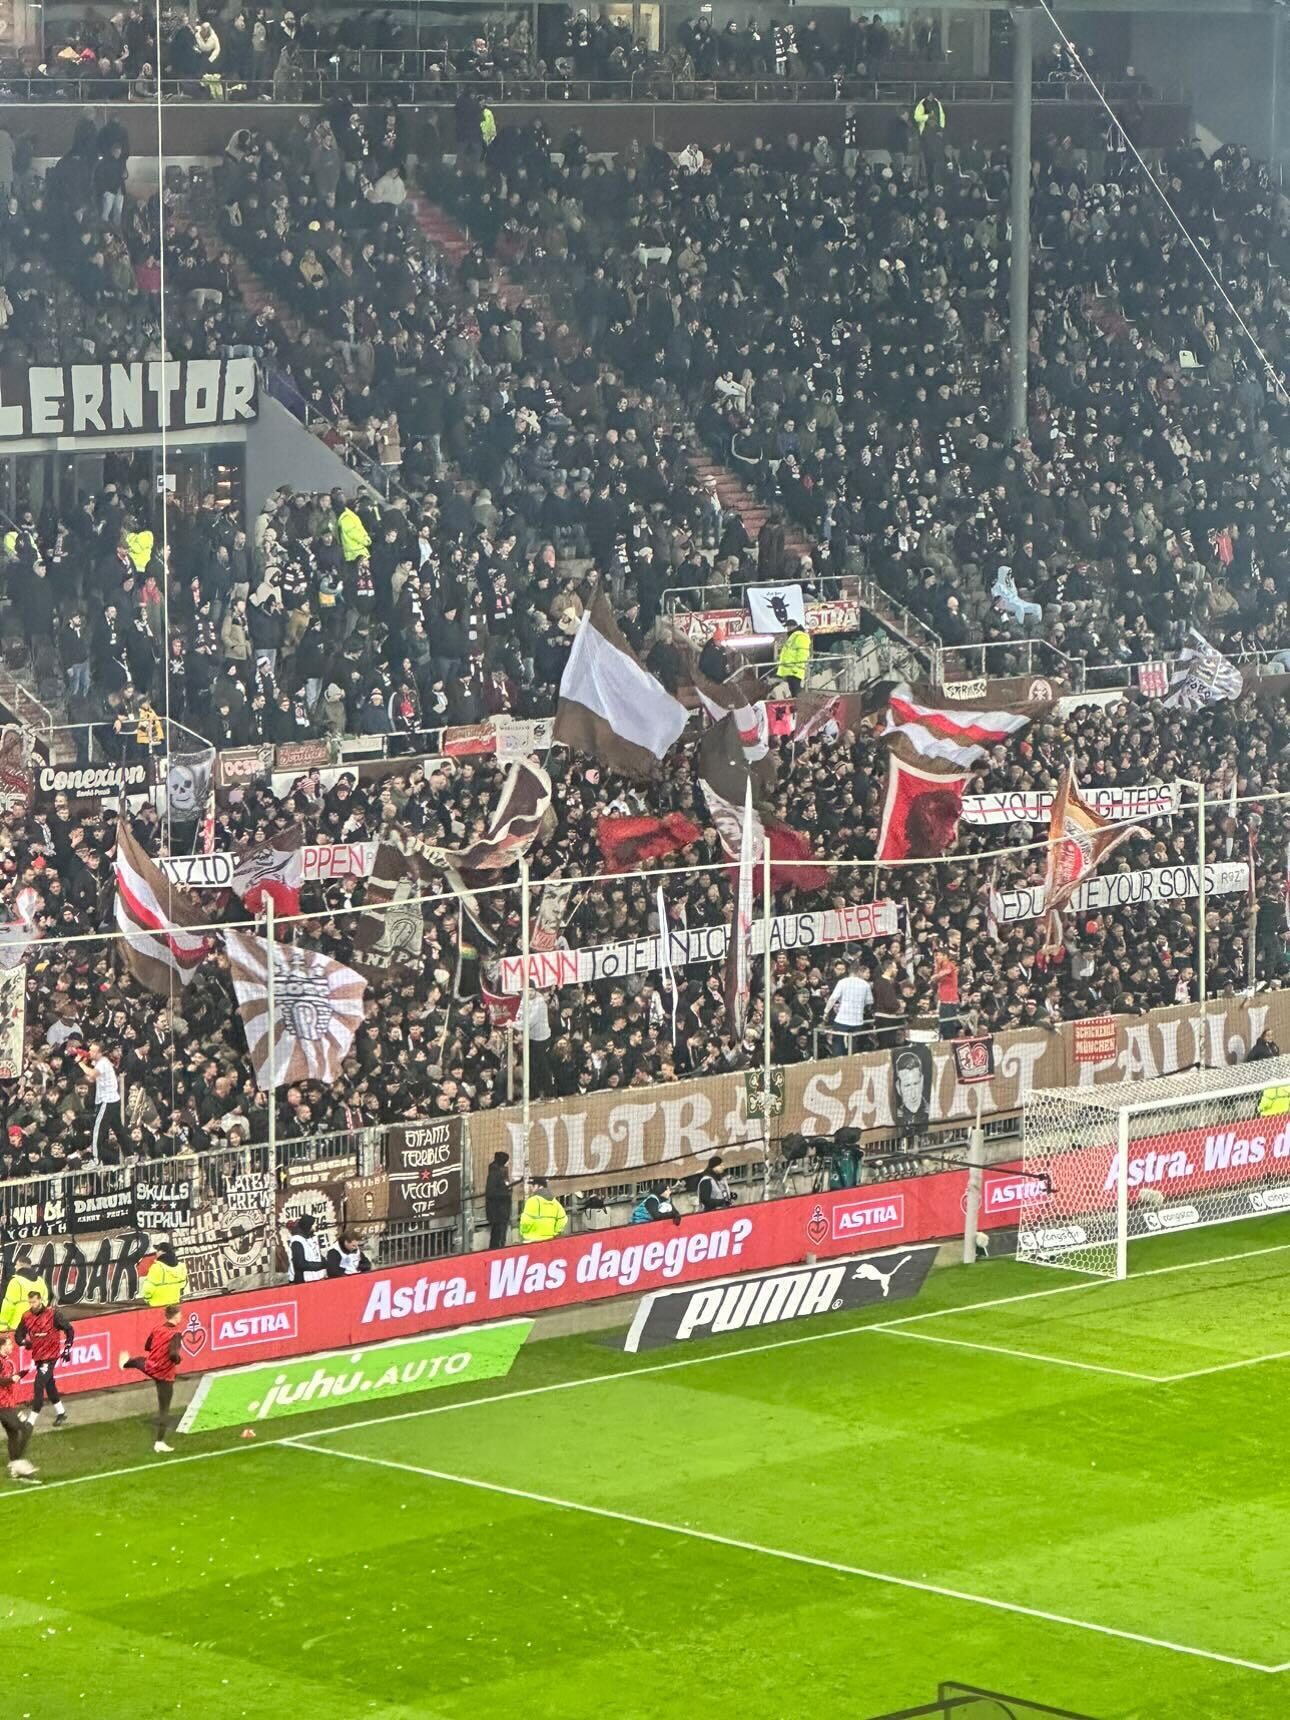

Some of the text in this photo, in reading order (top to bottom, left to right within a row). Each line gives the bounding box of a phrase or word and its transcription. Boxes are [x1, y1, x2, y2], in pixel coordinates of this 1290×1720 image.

[1105, 871, 1153, 905] YOUR
[1160, 866, 1215, 898] SONS
[503, 951, 578, 990] MANN
[669, 921, 756, 965] NICH
[769, 914, 815, 949] AUS
[822, 902, 888, 942] LIEBE
[404, 1124, 450, 1147] ENFANTS
[1103, 1150, 1194, 1191] Astra.
[1204, 1131, 1266, 1172] Was
[136, 1182, 189, 1201] SKULLS
[7, 1223, 67, 1240] YOUTH
[838, 1204, 897, 1230] ASTRA
[361, 1218, 753, 1323] Astra. Was dagegen?
[675, 1265, 847, 1340] PUMA
[219, 1311, 290, 1341] ASTRA
